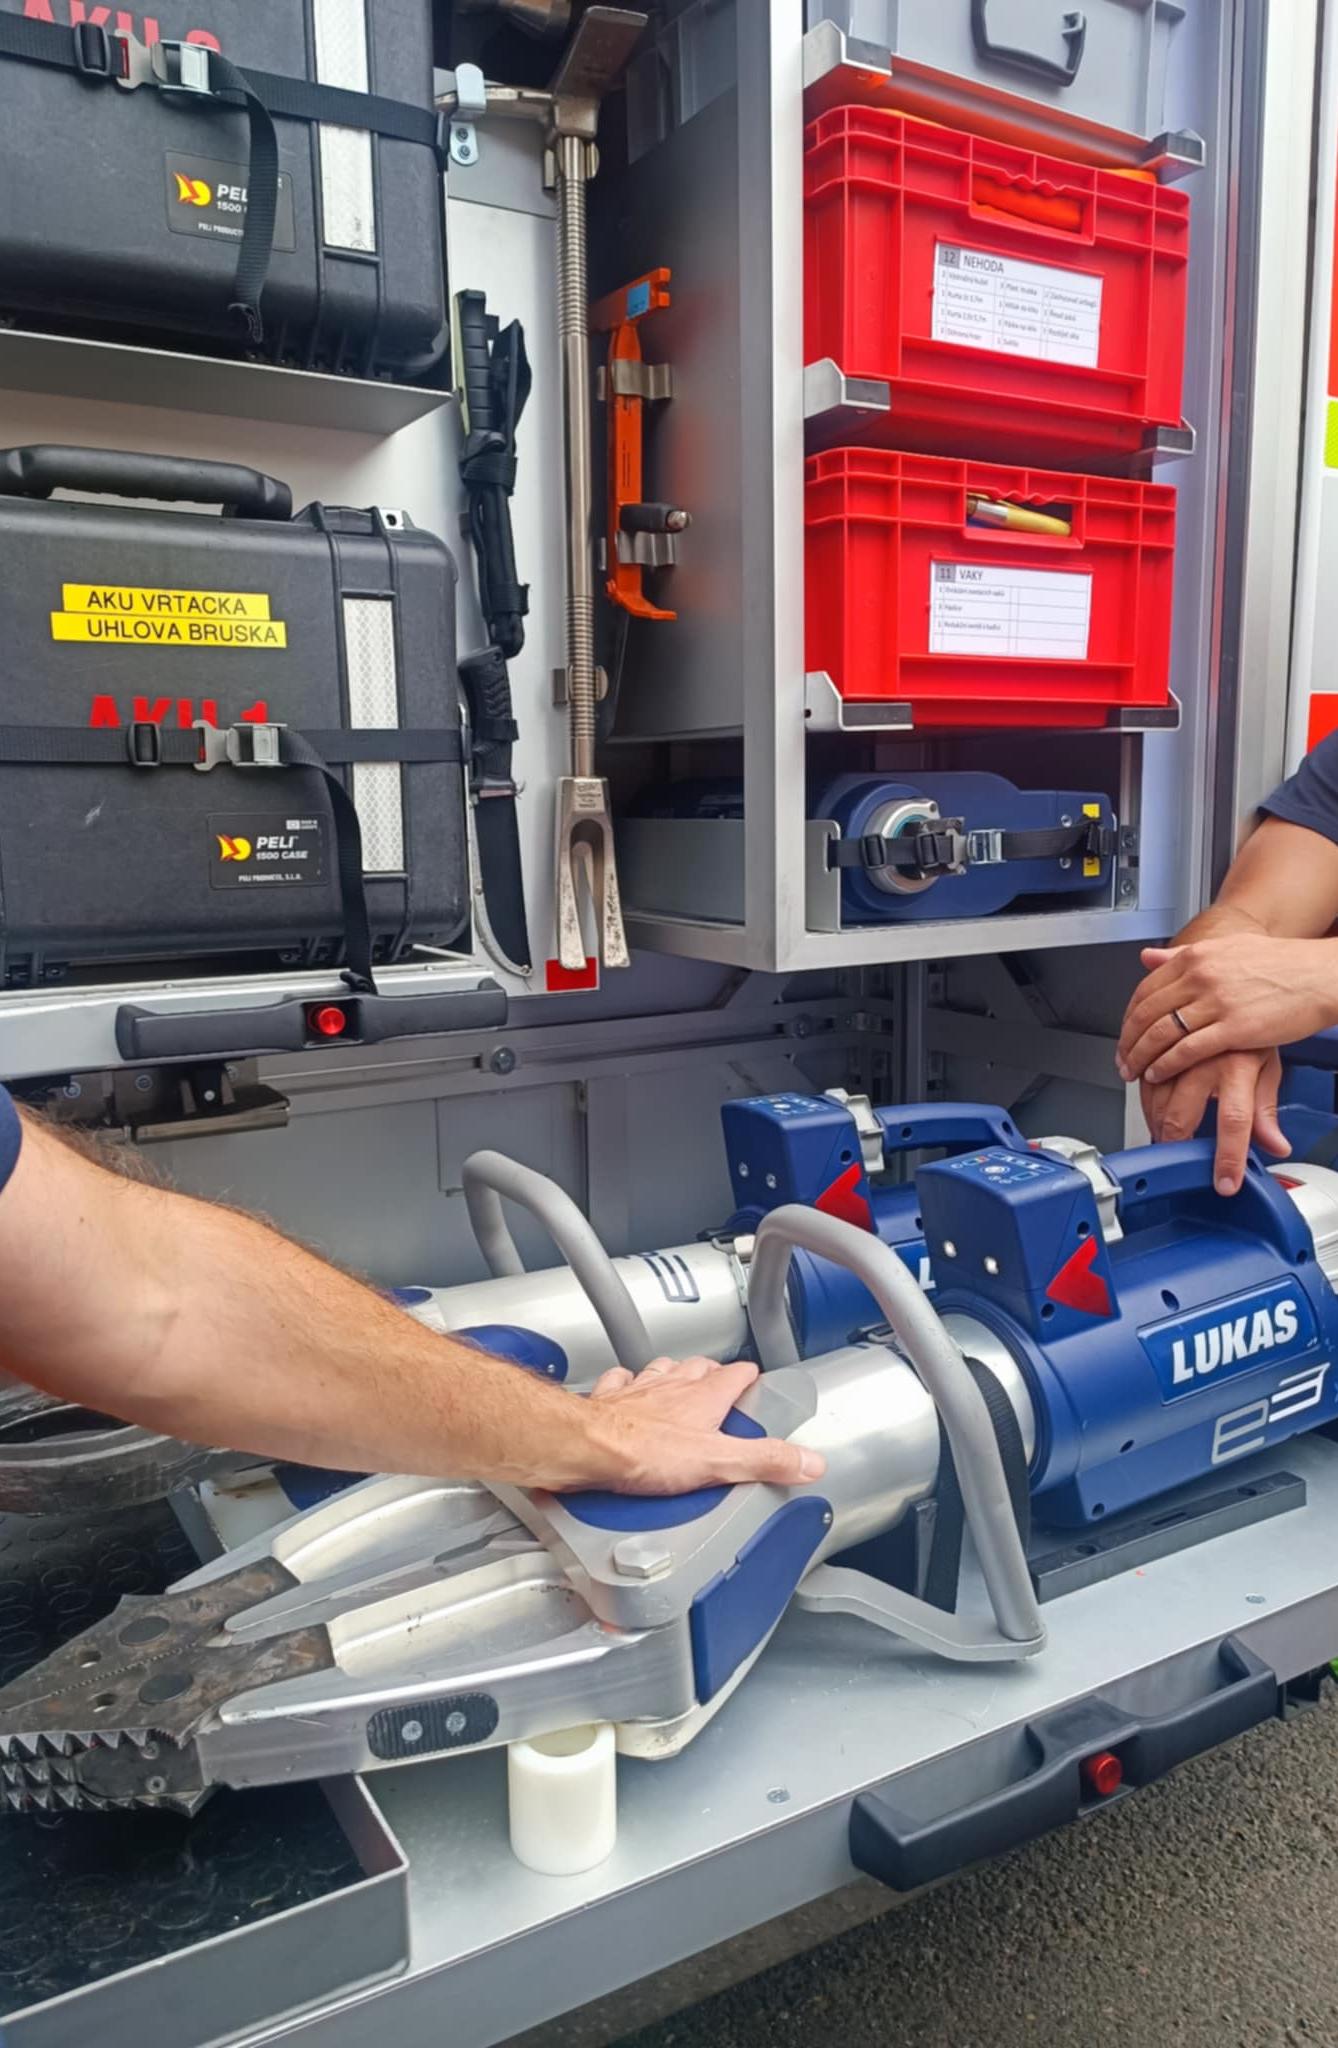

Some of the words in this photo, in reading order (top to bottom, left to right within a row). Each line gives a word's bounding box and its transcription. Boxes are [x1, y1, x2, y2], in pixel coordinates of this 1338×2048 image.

[217, 183, 248, 203] PEL
[217, 200, 242, 213] 1500
[943, 250, 956, 265] 12
[963, 255, 1004, 273] NEHODA
[940, 567, 951, 579] 11
[959, 568, 984, 580] VAKY
[87, 591, 133, 610] AKU
[141, 594, 247, 615] VRTACKA
[87, 619, 182, 640] UHLOVA
[189, 623, 278, 643] BRUSKA
[256, 836, 295, 849] PELI
[256, 851, 279, 860] 1500
[281, 850, 309, 859] CASE
[1172, 1300, 1298, 1384] LUKAS
